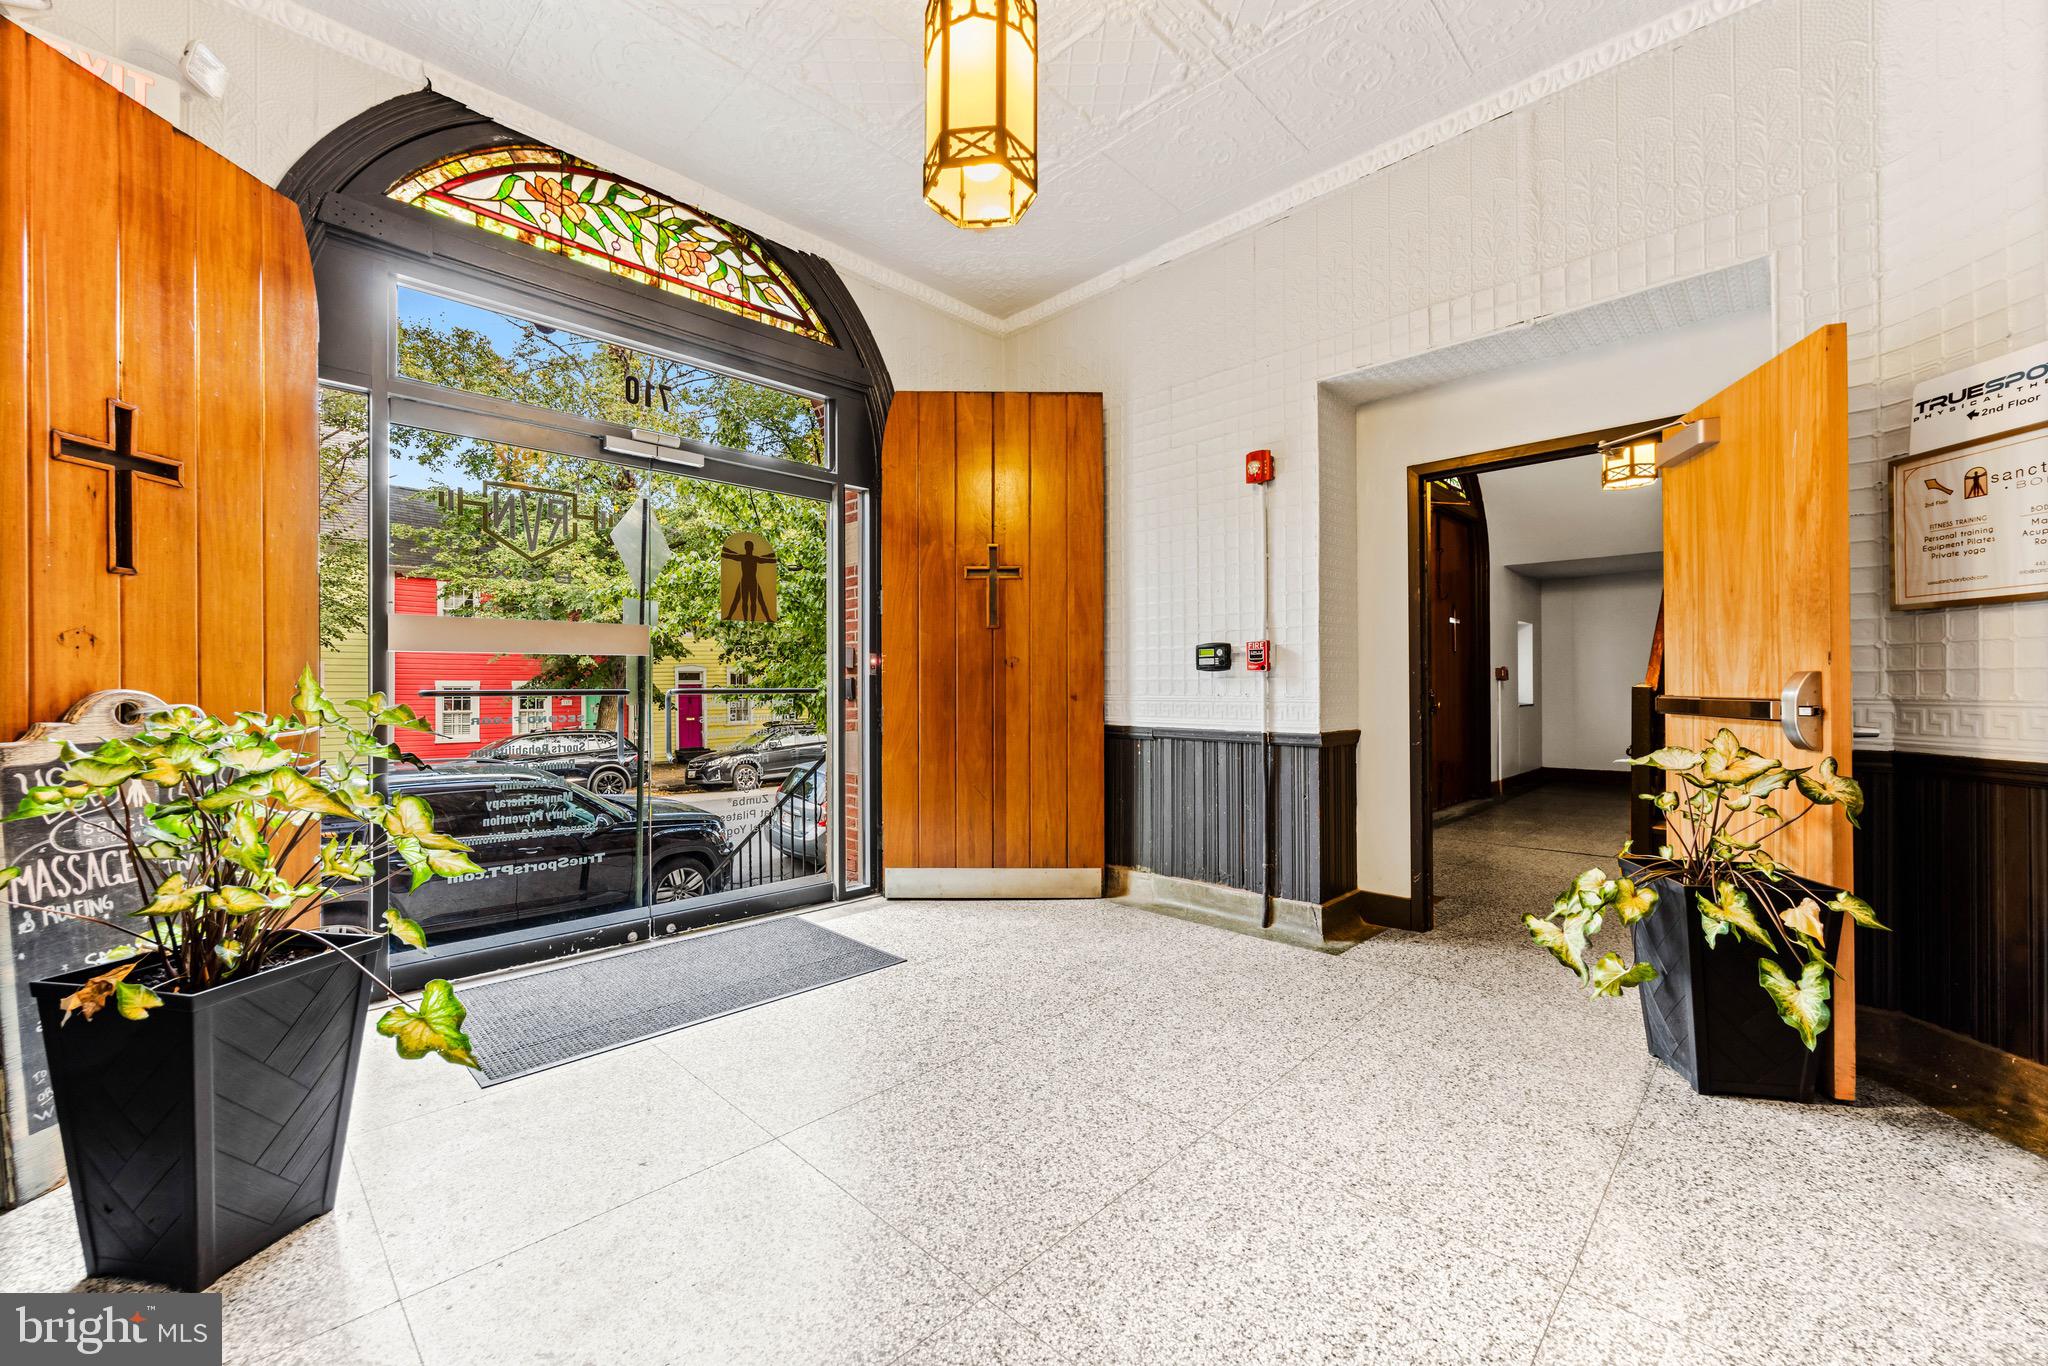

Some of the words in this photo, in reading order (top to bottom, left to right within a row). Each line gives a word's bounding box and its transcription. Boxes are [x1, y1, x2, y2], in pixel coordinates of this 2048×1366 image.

[50, 38, 155, 107] XIT
[1915, 363, 2048, 414] TRUESPO
[1913, 393, 2003, 422] PHYSICAL
[1981, 404, 2004, 417] 2nd
[2008, 394, 2041, 409] Floor
[1991, 461, 2048, 484] sanct
[2016, 477, 2048, 489] BO
[1924, 532, 1957, 543] Personal
[1961, 526, 1994, 537] training
[1929, 520, 1953, 531] FITNESS
[1955, 515, 1988, 525] TRAINING
[1922, 541, 1964, 553] Equipment
[1967, 536, 1996, 545] Pilates
[1931, 551, 1960, 560] Private
[1963, 547, 1986, 557] yoga
[1248, 641, 1264, 649] FIRE
[11, 850, 139, 909] MASSAGE
[42, 894, 114, 927] ROLFING
